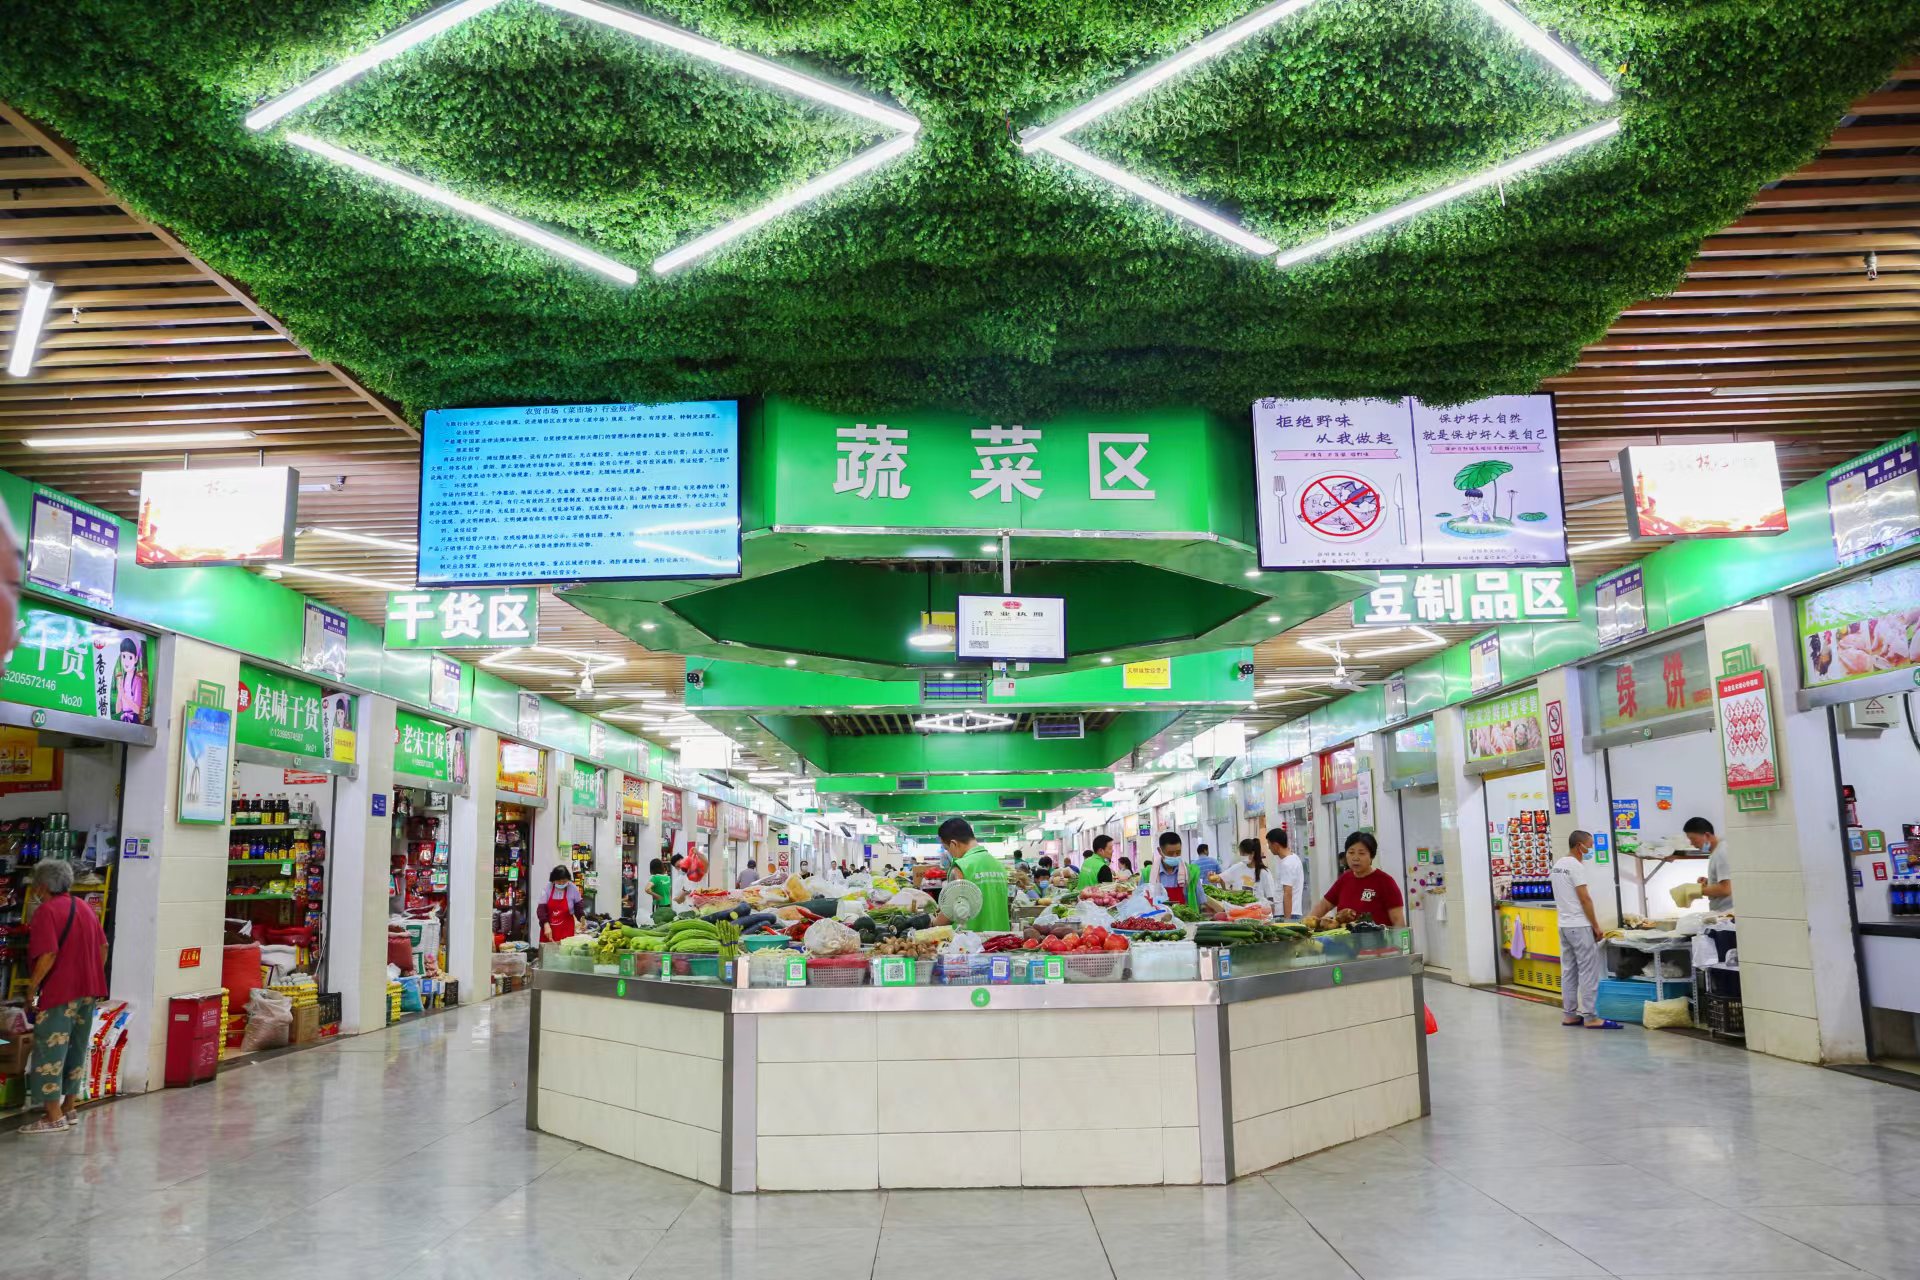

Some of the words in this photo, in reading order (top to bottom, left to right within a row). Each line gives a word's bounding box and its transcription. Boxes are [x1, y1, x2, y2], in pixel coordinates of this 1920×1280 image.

[1276, 414, 1354, 428] 拒绝野味
[1439, 412, 1522, 424] 保护好大自然
[1316, 432, 1394, 445] 从我做起
[1422, 428, 1548, 441] 就是保护好人类自己
[833, 423, 1155, 503] 蔬菜区
[1365, 571, 1568, 621] 豆制品区
[389, 592, 530, 640] 干货区
[1, 668, 56, 692] 5205572146
[254, 683, 320, 733] 侯啸干货
[402, 724, 445, 761] 老宋干货
